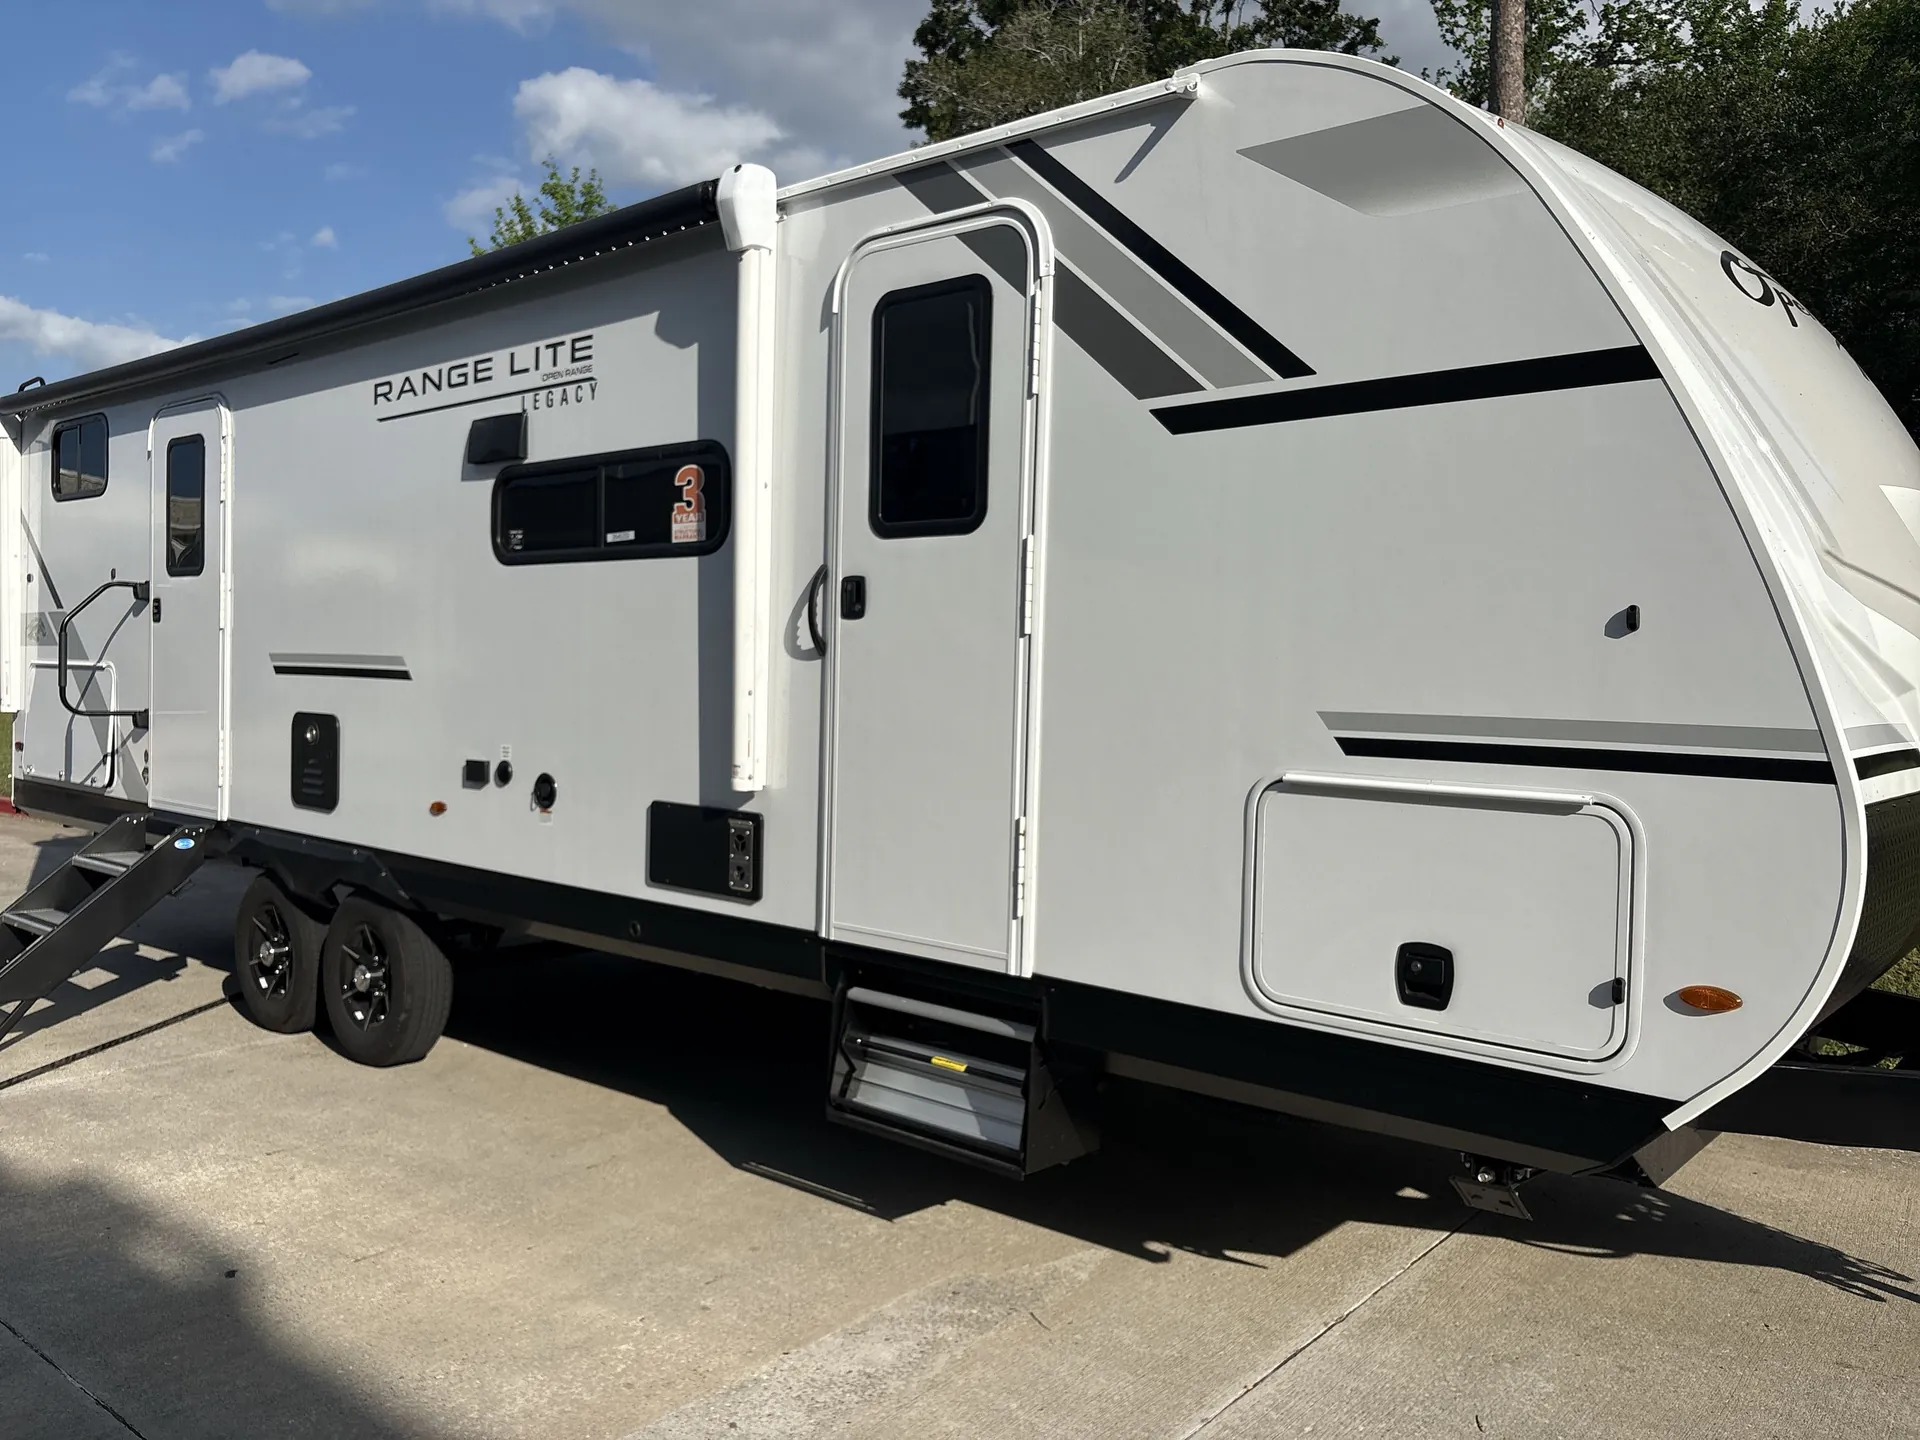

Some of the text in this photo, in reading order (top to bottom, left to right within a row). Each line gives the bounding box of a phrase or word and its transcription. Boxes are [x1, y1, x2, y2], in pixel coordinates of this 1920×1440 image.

[374, 334, 594, 405] RANGE LITE
[542, 365, 593, 382] OPEN RANGE
[521, 382, 598, 412] LEGACY
[674, 464, 705, 512] 3
[675, 512, 703, 523] YEAR
